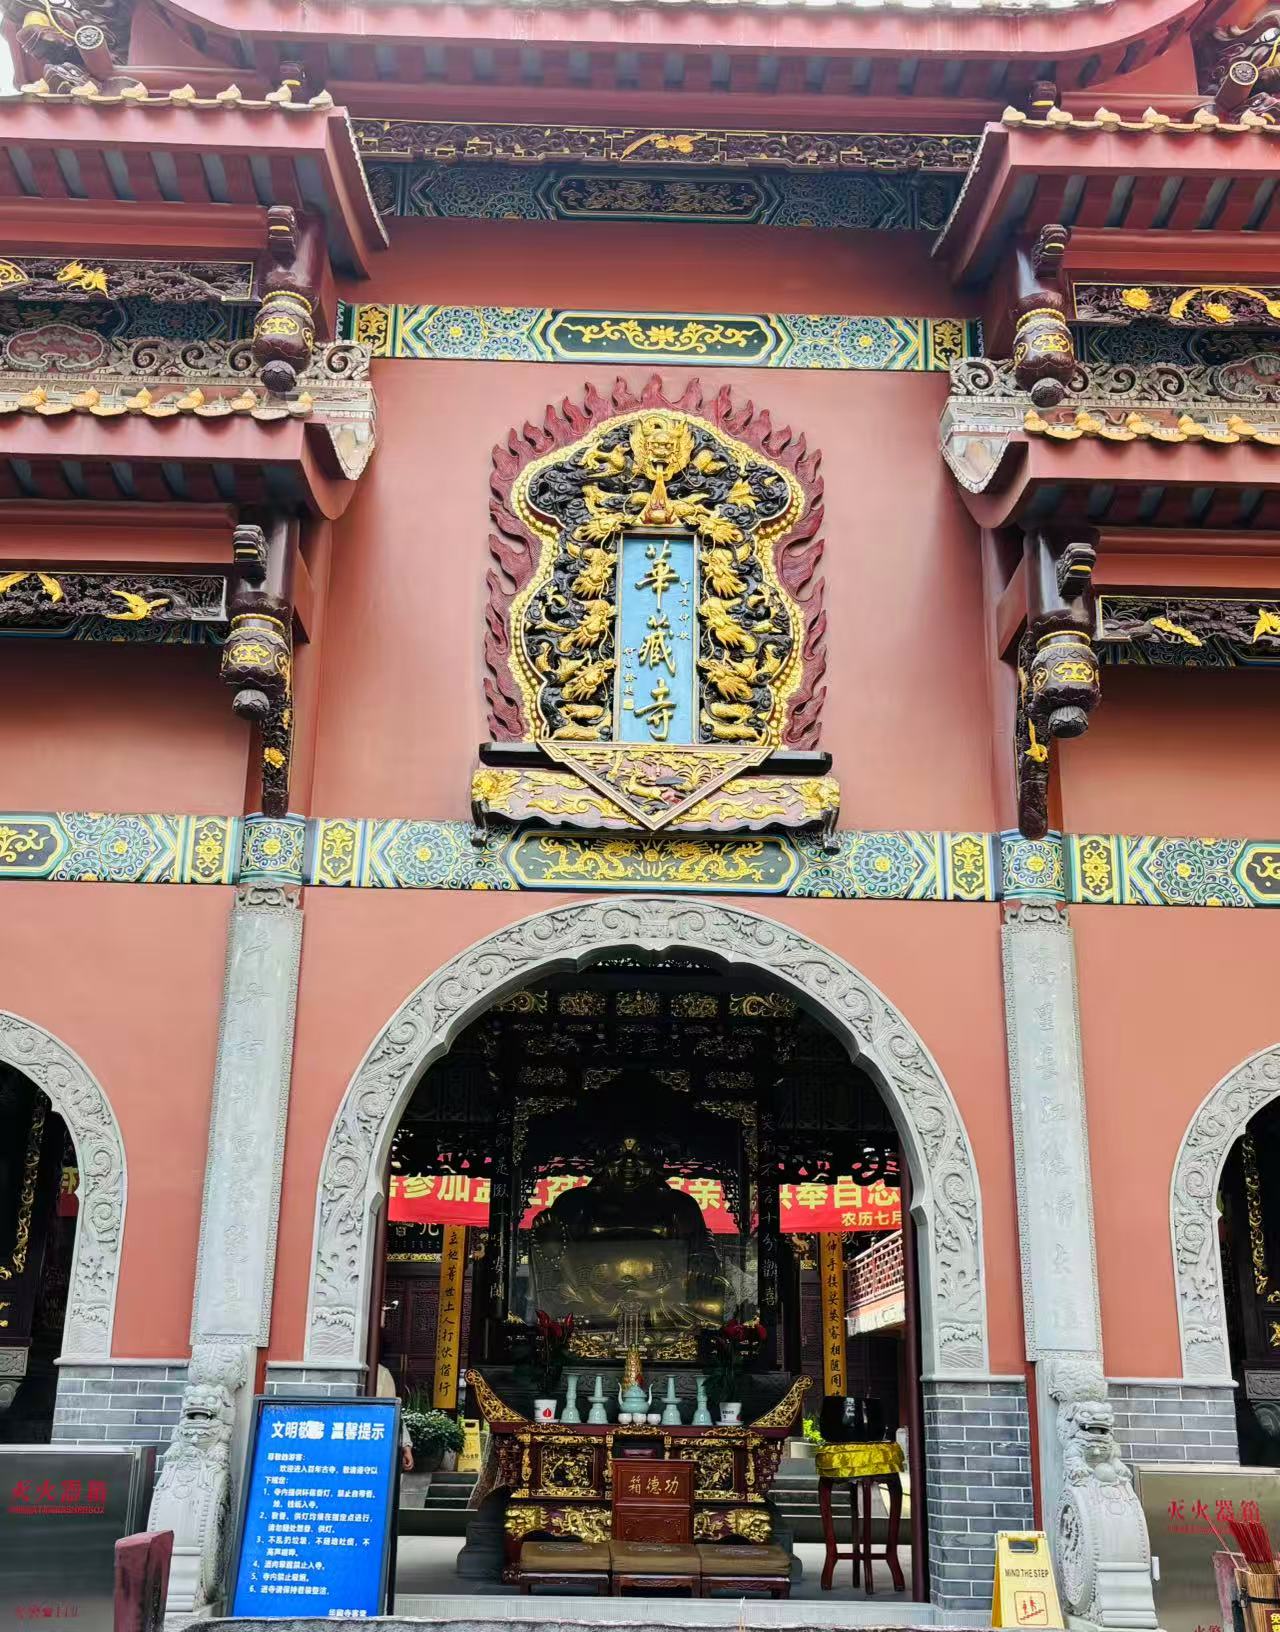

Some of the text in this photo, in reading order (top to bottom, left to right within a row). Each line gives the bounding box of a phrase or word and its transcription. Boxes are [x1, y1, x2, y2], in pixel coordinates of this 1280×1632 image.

[634, 539, 680, 741] 華藏寺
[331, 1421, 386, 1441] 温馨提示
[1005, 1568, 1049, 1578] MIND THE STEP
